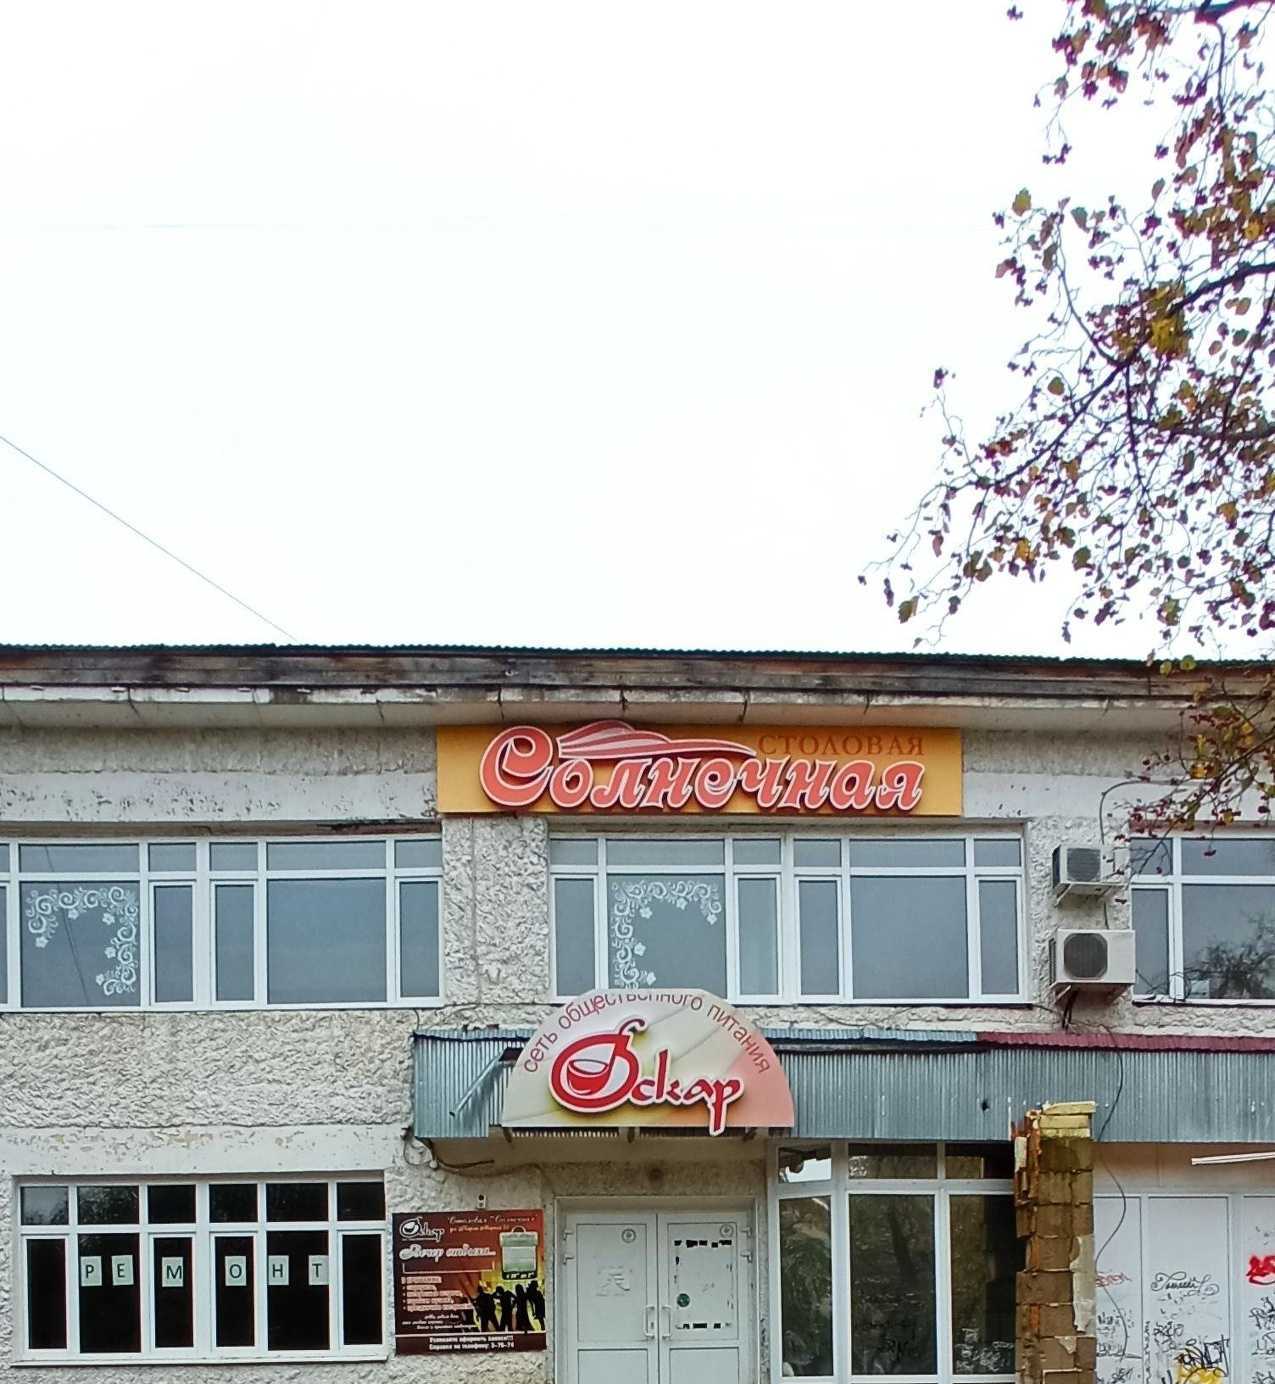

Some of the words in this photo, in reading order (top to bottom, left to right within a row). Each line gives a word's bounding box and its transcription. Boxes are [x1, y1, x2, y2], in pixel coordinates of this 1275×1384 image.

[480, 725, 926, 811] Солнечная
[758, 735, 925, 756] СТОЛОВАЯ
[523, 1030, 559, 1074] сеть
[706, 1003, 771, 1074] питания
[550, 1018, 744, 1134] Оскар
